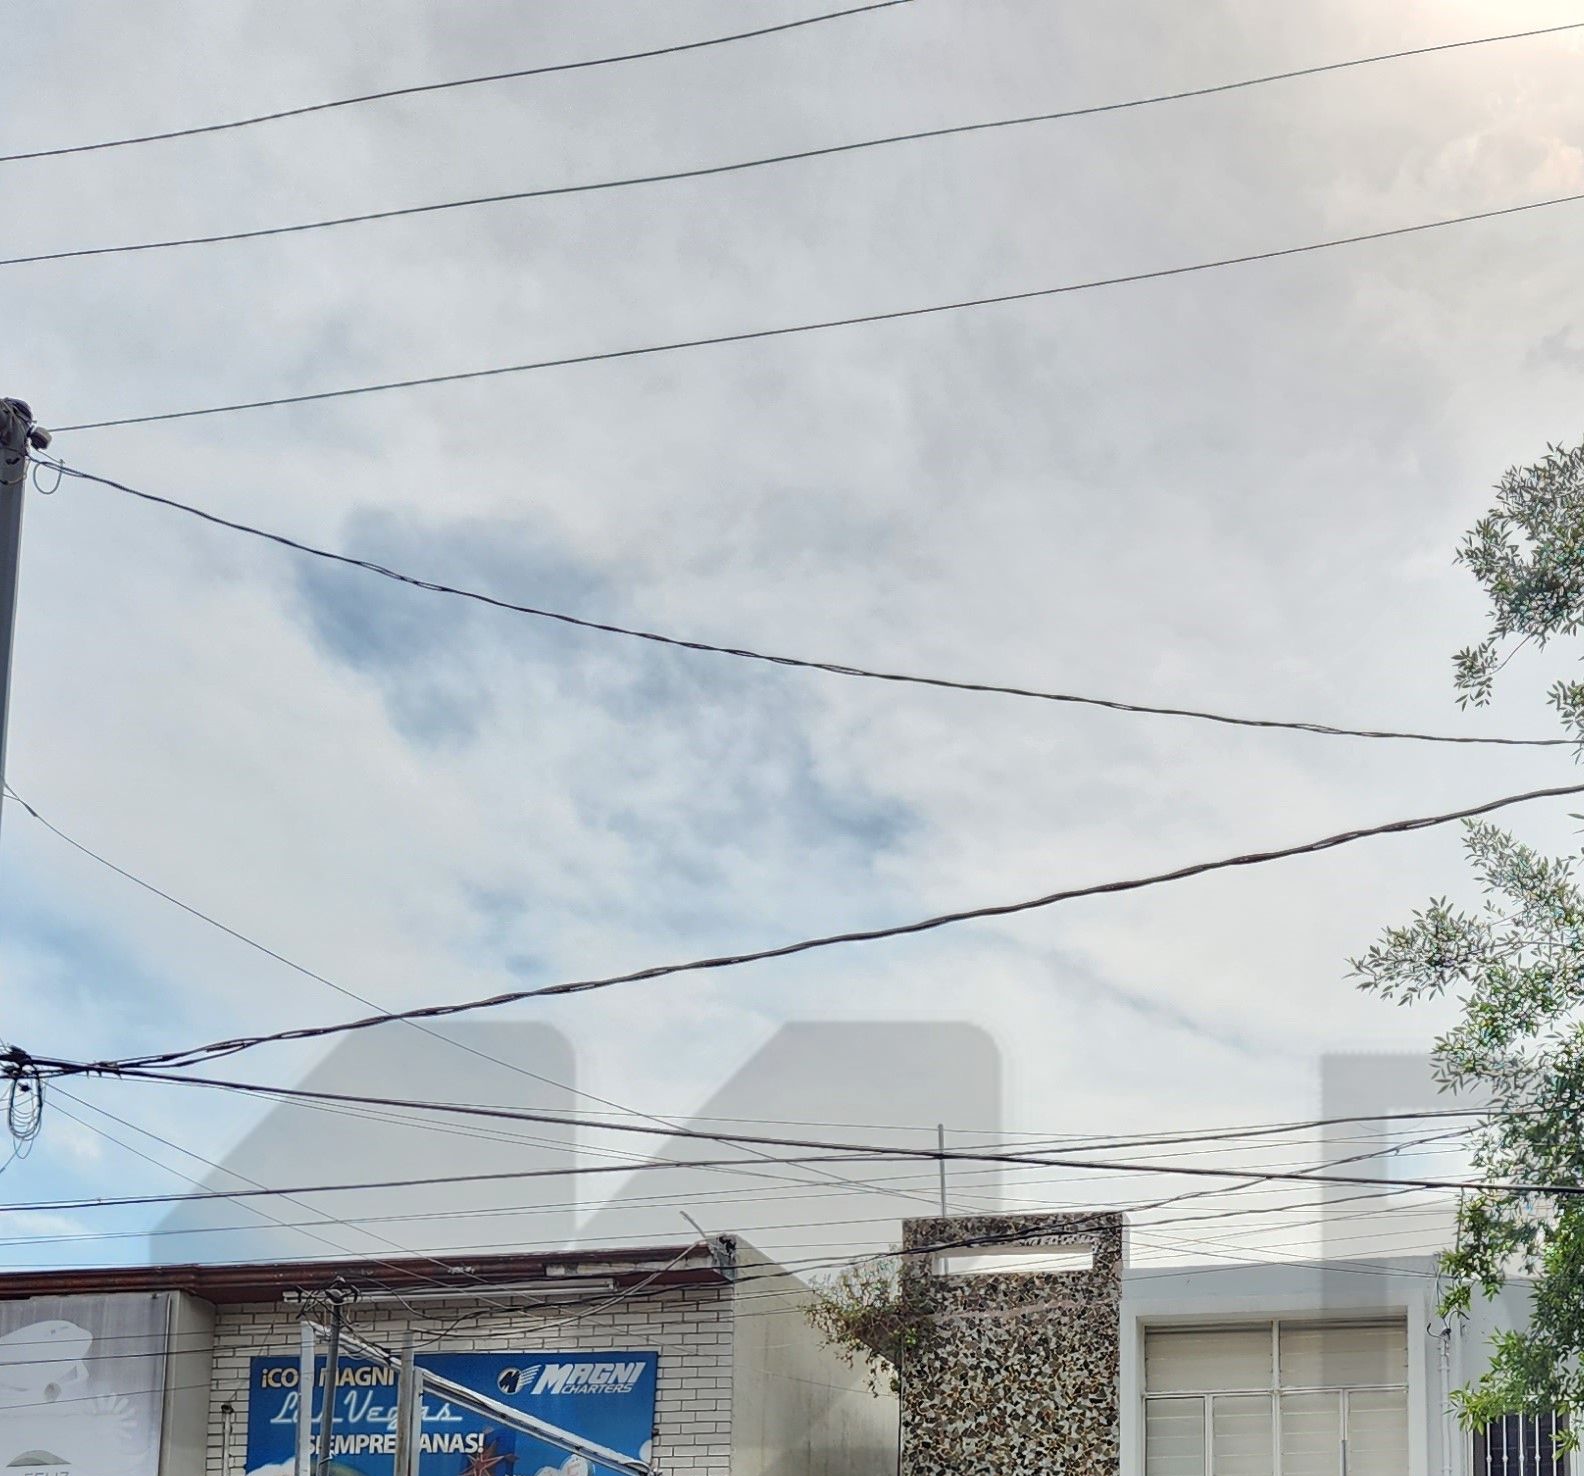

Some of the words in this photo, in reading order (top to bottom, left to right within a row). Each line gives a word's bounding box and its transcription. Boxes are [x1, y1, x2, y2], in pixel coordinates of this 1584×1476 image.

[261, 1367, 299, 1388] ¡CO
[530, 1362, 646, 1394] MAGNI
[561, 1383, 634, 1394] CHARTERS
[420, 1432, 484, 1454] ANAS!
